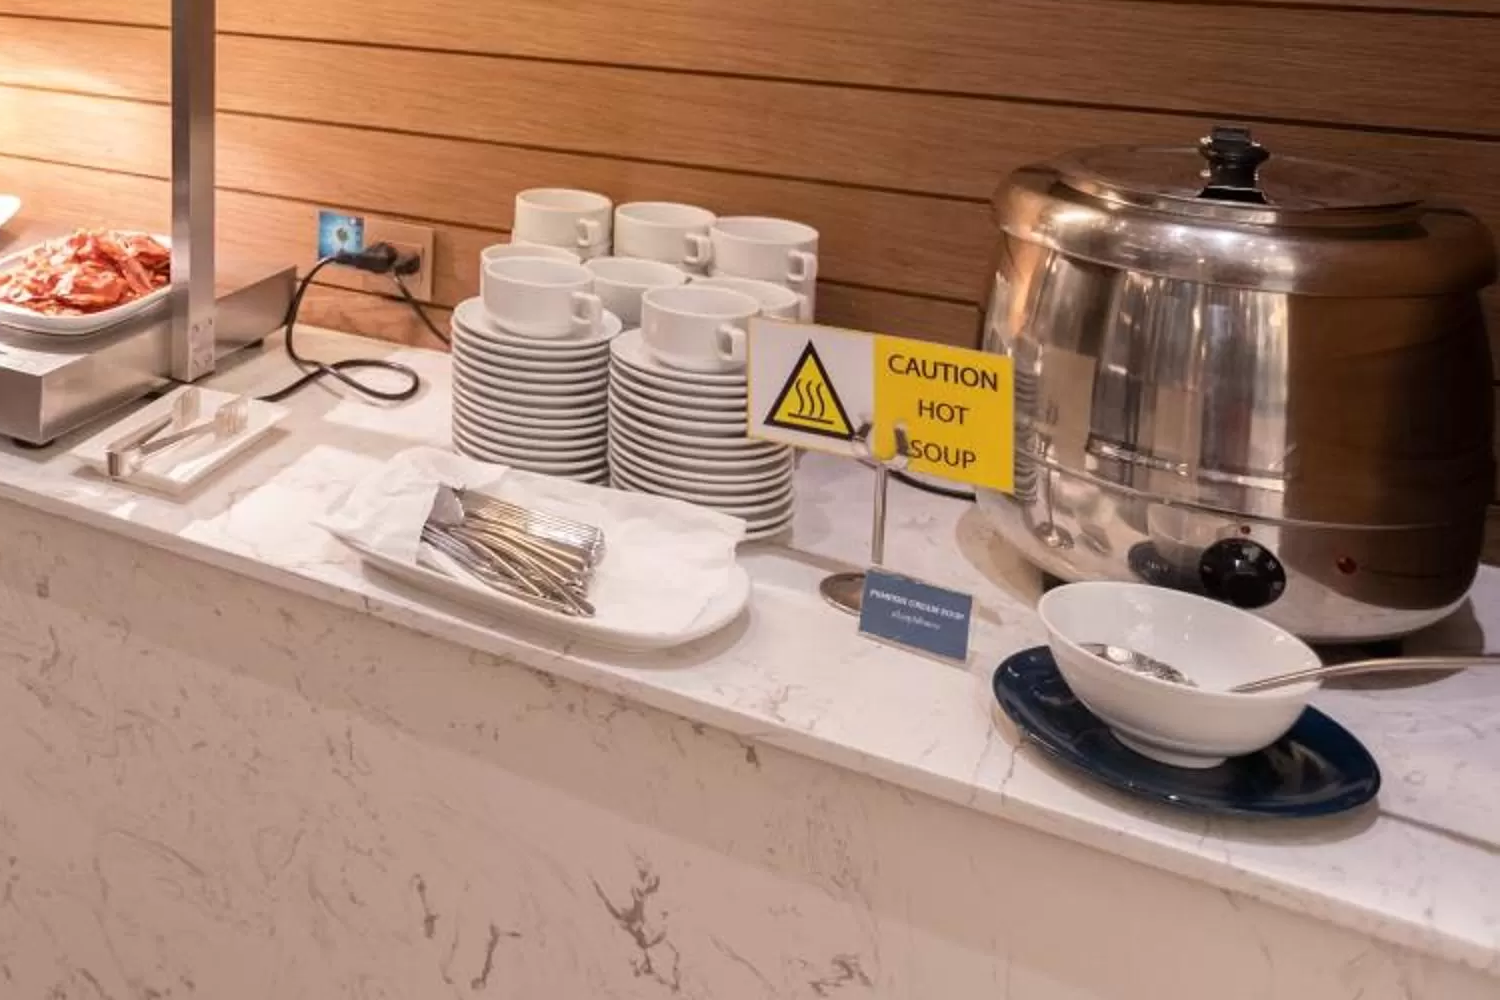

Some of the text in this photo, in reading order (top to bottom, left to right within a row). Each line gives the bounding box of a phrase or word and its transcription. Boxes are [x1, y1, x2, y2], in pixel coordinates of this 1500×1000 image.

[888, 354, 998, 392] CAUTION
[918, 399, 970, 425] HOT
[910, 440, 977, 468] SOUP
